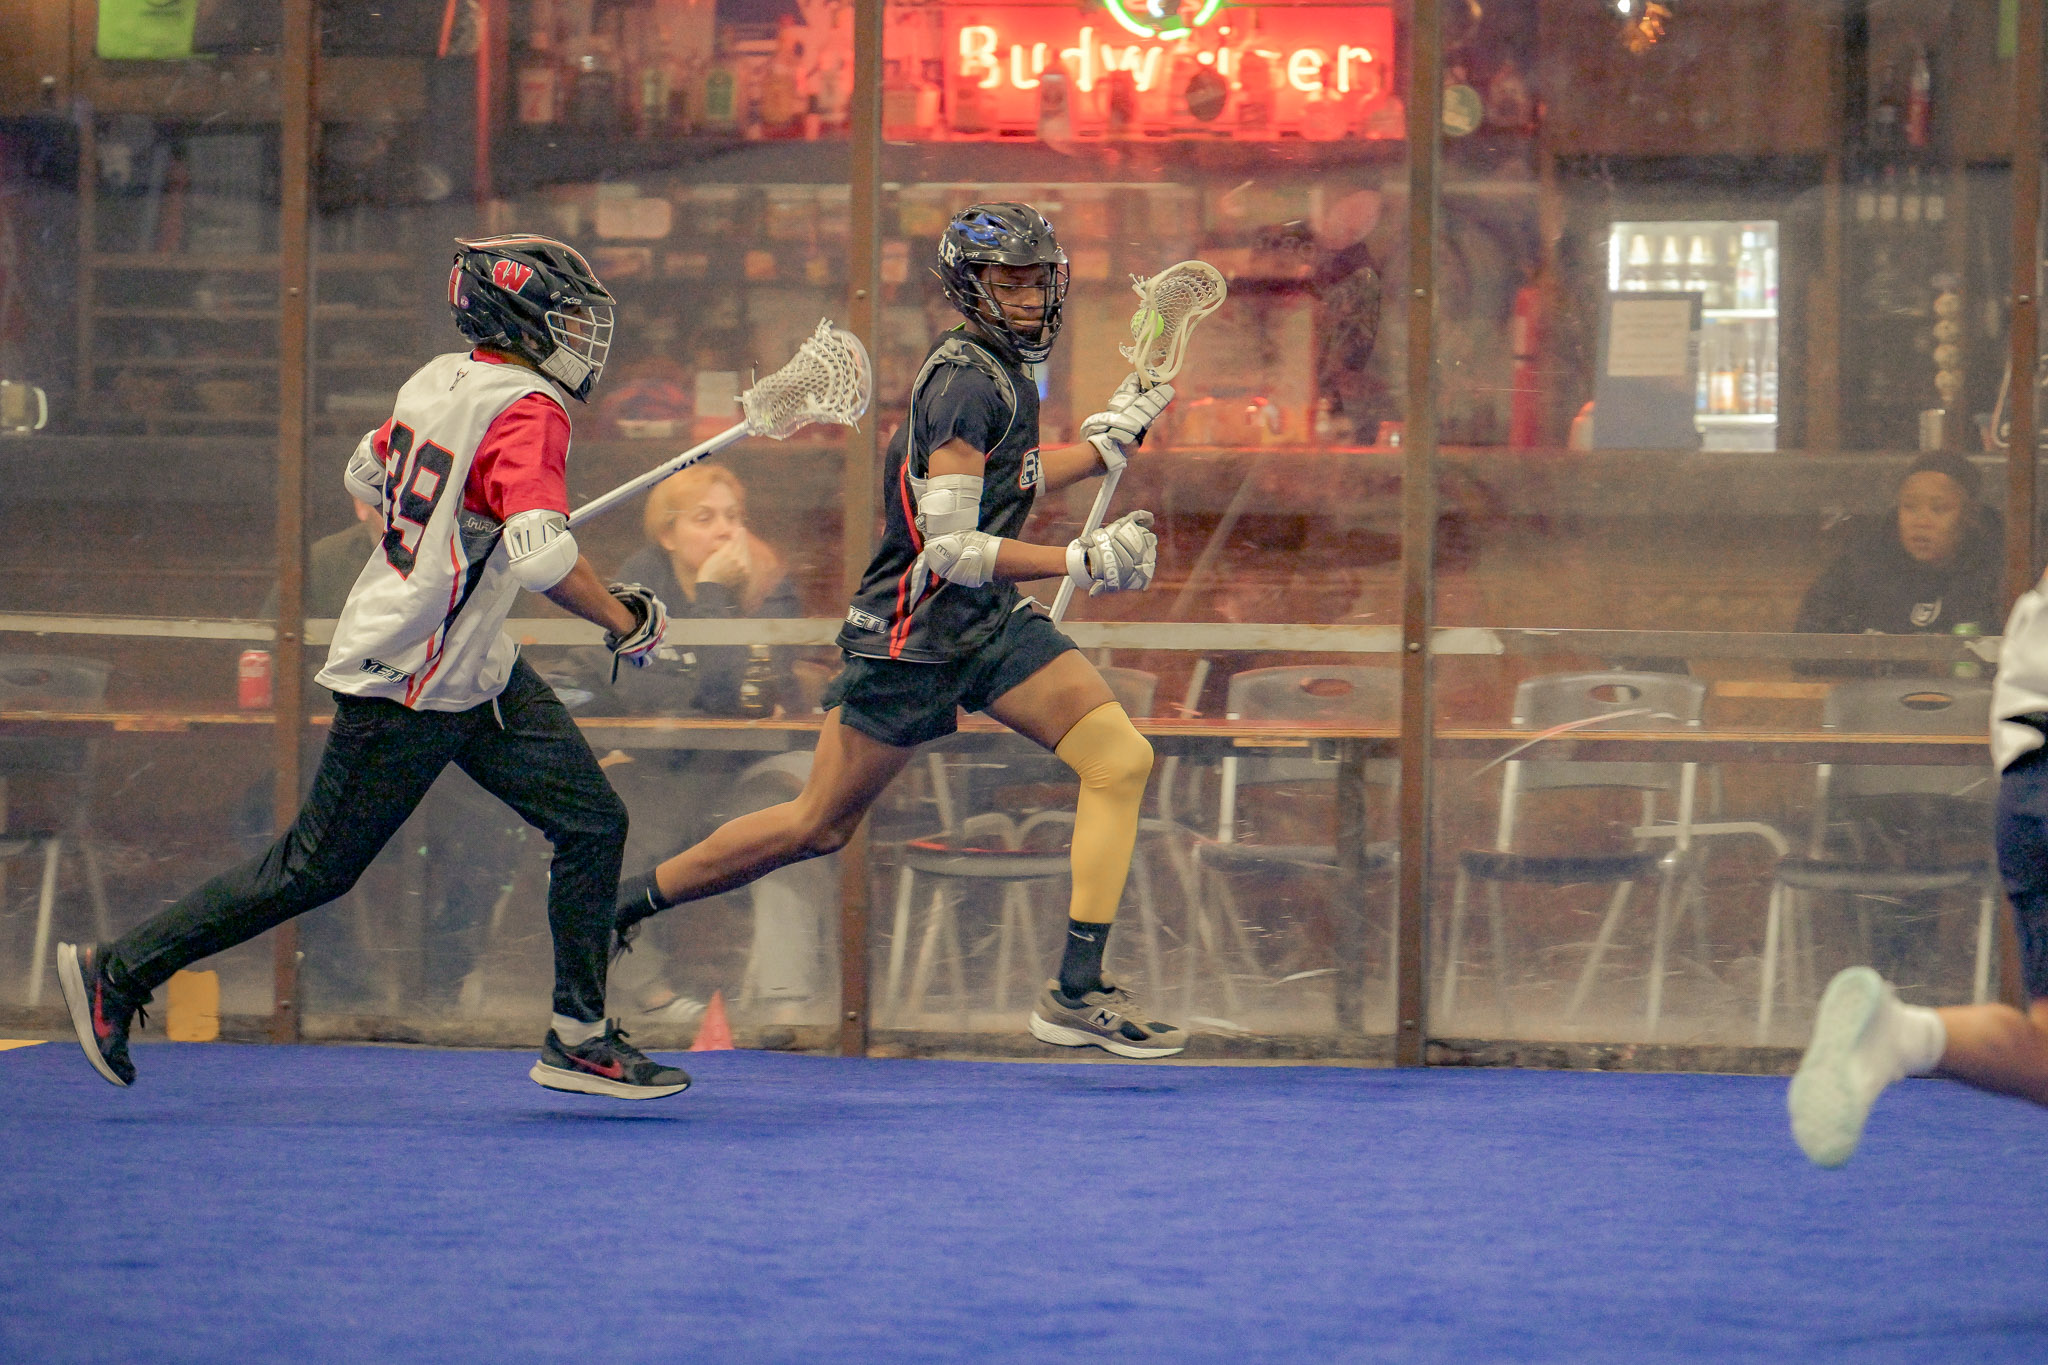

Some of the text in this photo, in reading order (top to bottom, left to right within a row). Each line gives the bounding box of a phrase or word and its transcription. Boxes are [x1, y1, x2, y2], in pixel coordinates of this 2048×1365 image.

[959, 25, 1372, 92] Budwier
[492, 259, 534, 294] W
[1096, 533, 1120, 588] ADIDAS
[845, 605, 889, 633] YETI
